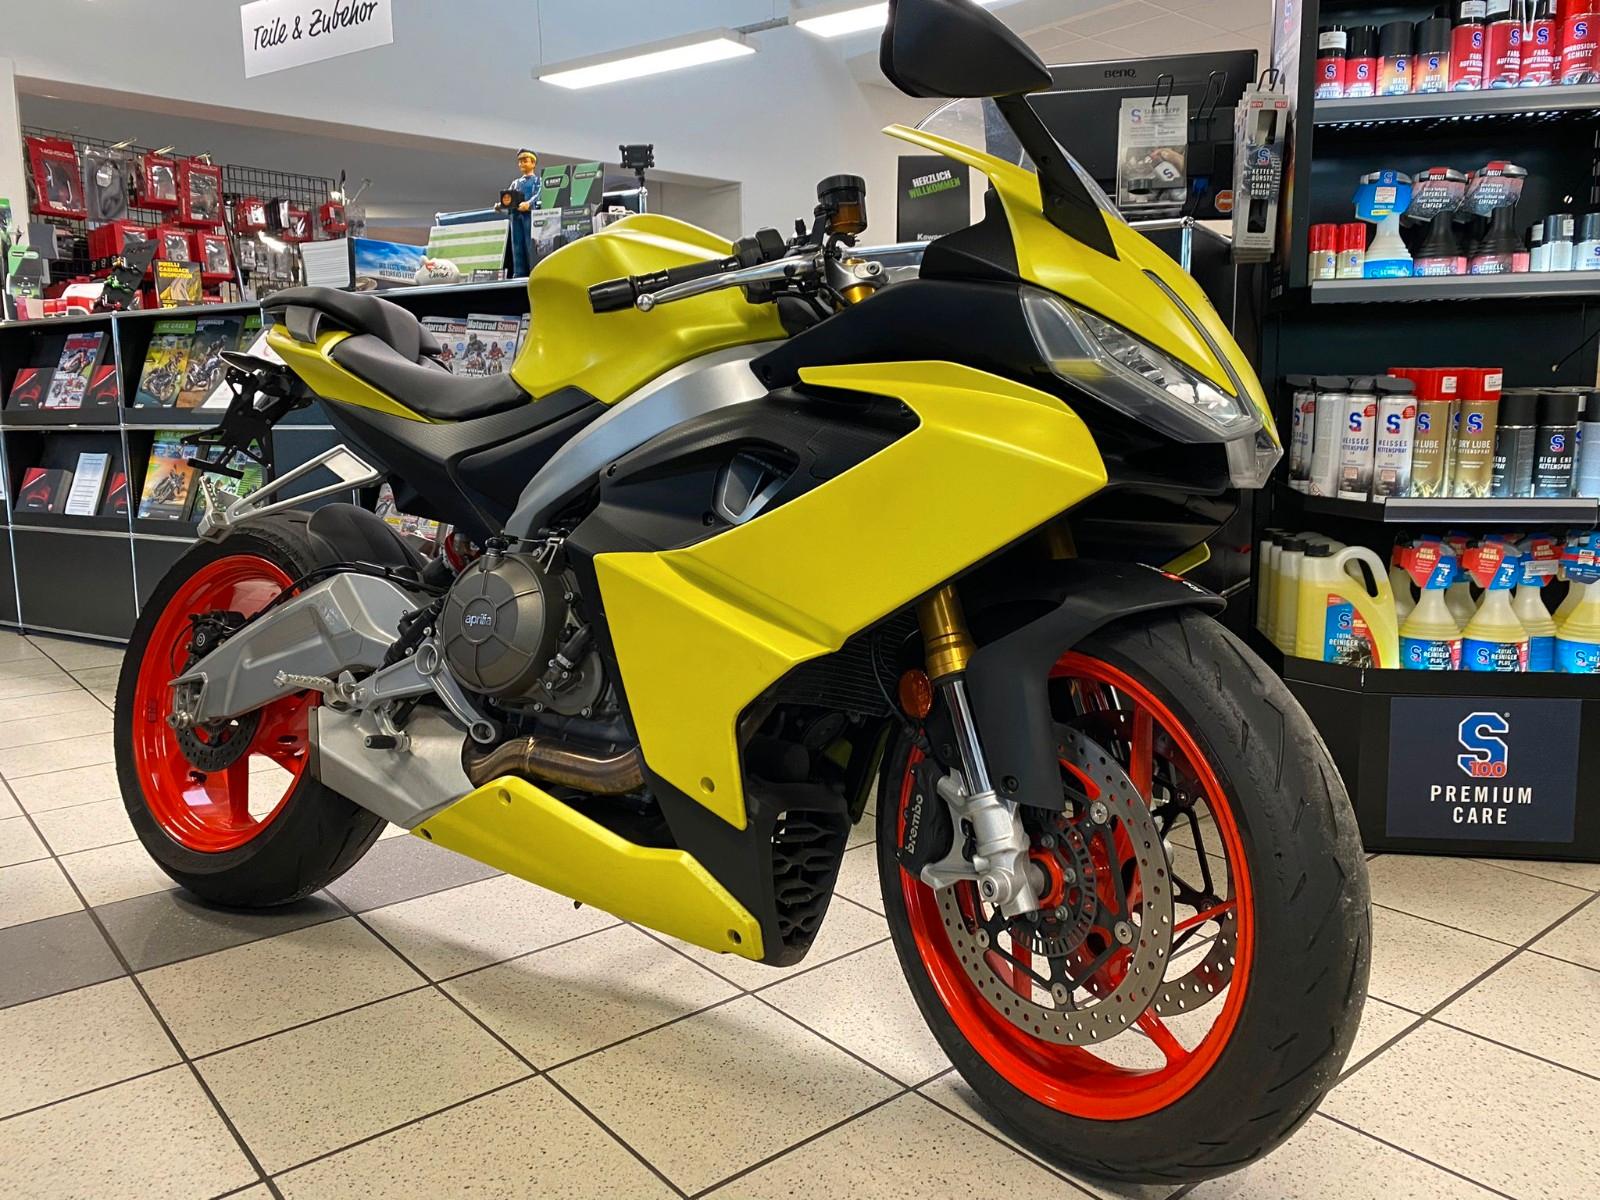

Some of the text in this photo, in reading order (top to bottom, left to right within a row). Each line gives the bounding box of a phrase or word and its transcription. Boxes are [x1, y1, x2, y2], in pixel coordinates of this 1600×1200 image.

[254, 17, 288, 50] Teile
[292, 15, 303, 40] &
[908, 177, 961, 199] WILLKOMMEN
[912, 170, 952, 188] HERZLICH
[468, 319, 517, 332] Motorrad Szene
[465, 613, 492, 627] aprilia
[1430, 785, 1533, 804] PREMIUM
[905, 794, 924, 855] brembo
[1453, 806, 1508, 825] CARE
